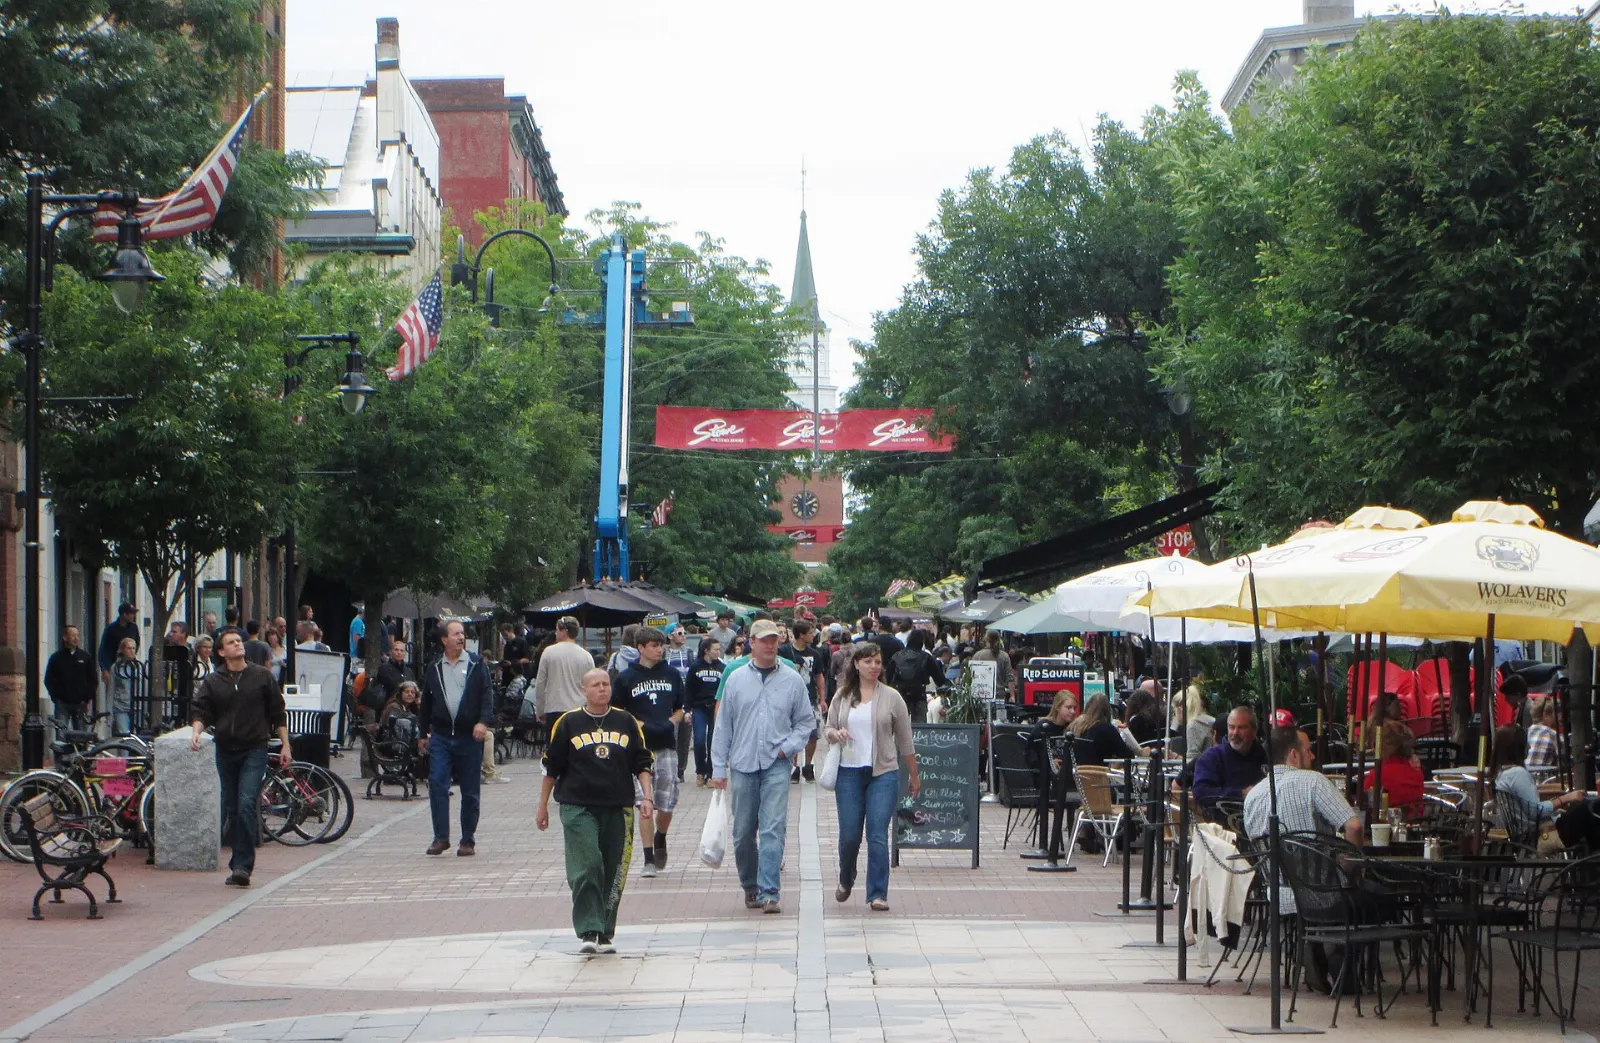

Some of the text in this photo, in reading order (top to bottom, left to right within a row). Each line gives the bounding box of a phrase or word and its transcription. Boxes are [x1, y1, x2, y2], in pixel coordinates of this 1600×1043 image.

[687, 418, 745, 446] Stowe
[777, 419, 835, 447] Stowe
[867, 418, 925, 447] Stowe
[1158, 531, 1193, 548] STOP
[1477, 582, 1567, 607] WOLAVER'S
[648, 618, 668, 626] CAUTION
[1023, 668, 1080, 682] RED SQUARE
[631, 681, 673, 698] CHARLESTON
[570, 731, 630, 751] BRUINS
[914, 810, 962, 824] SANGRIA
